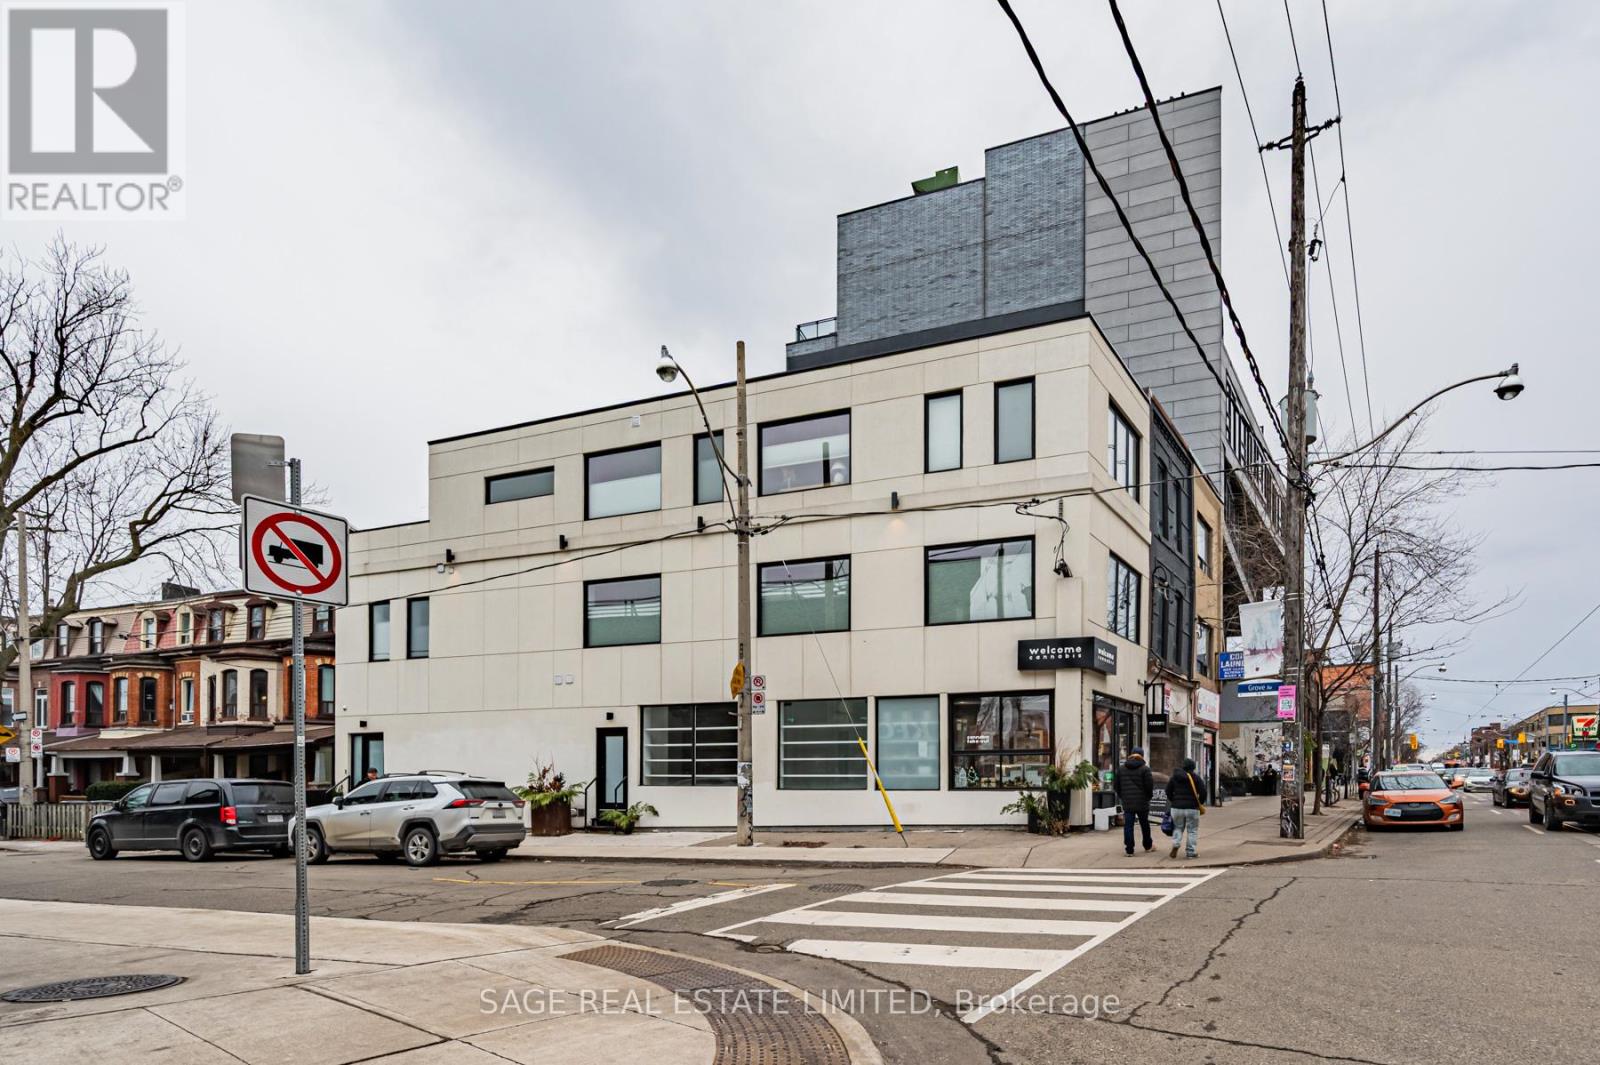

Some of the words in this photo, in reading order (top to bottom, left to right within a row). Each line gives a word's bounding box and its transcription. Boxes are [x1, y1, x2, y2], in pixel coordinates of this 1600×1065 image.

[1029, 645, 1082, 655] welcome
[1028, 653, 1082, 661] cannabis
[1247, 684, 1266, 692] Grove
